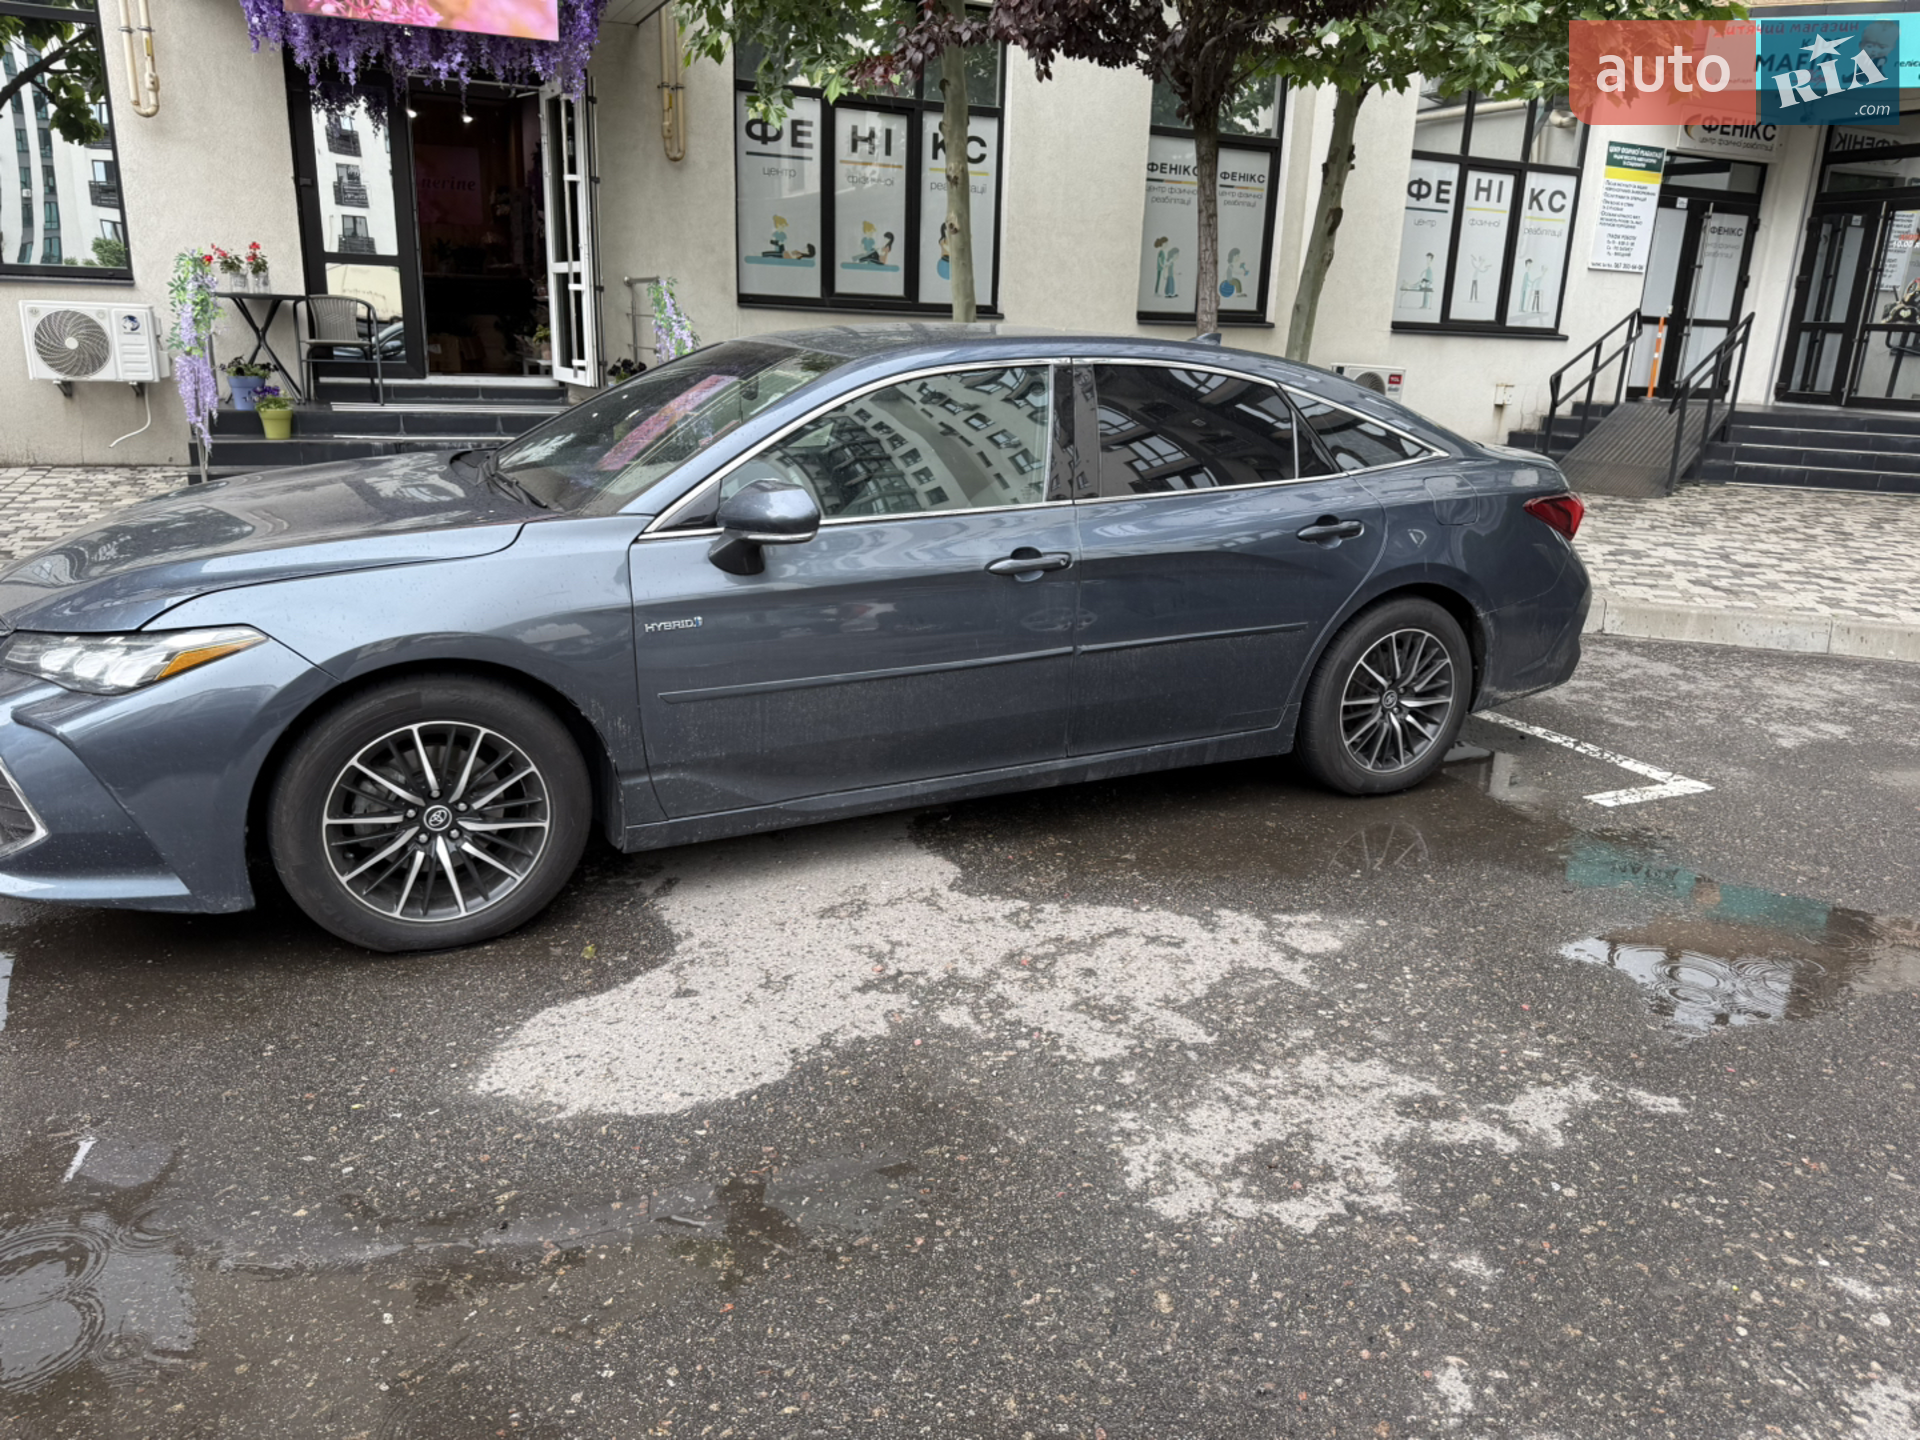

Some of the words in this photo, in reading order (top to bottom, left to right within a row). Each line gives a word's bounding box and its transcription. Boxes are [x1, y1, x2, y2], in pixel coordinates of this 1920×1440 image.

[1789, 21, 1859, 34] магазин
[1754, 53, 1835, 72] MAFIA
[745, 118, 814, 149] ФЕ
[851, 125, 892, 156] НІ
[1701, 115, 1777, 141] ФЕНІКС
[762, 166, 797, 179] центр
[930, 181, 987, 195] реаації
[1219, 171, 1266, 184] ФЕНІКС
[1407, 178, 1452, 204] ФЕ
[1474, 178, 1504, 203] НІ
[1528, 188, 1567, 213] КС
[1710, 226, 1744, 237] ФЕНІКС
[644, 619, 696, 632] HYBRID
